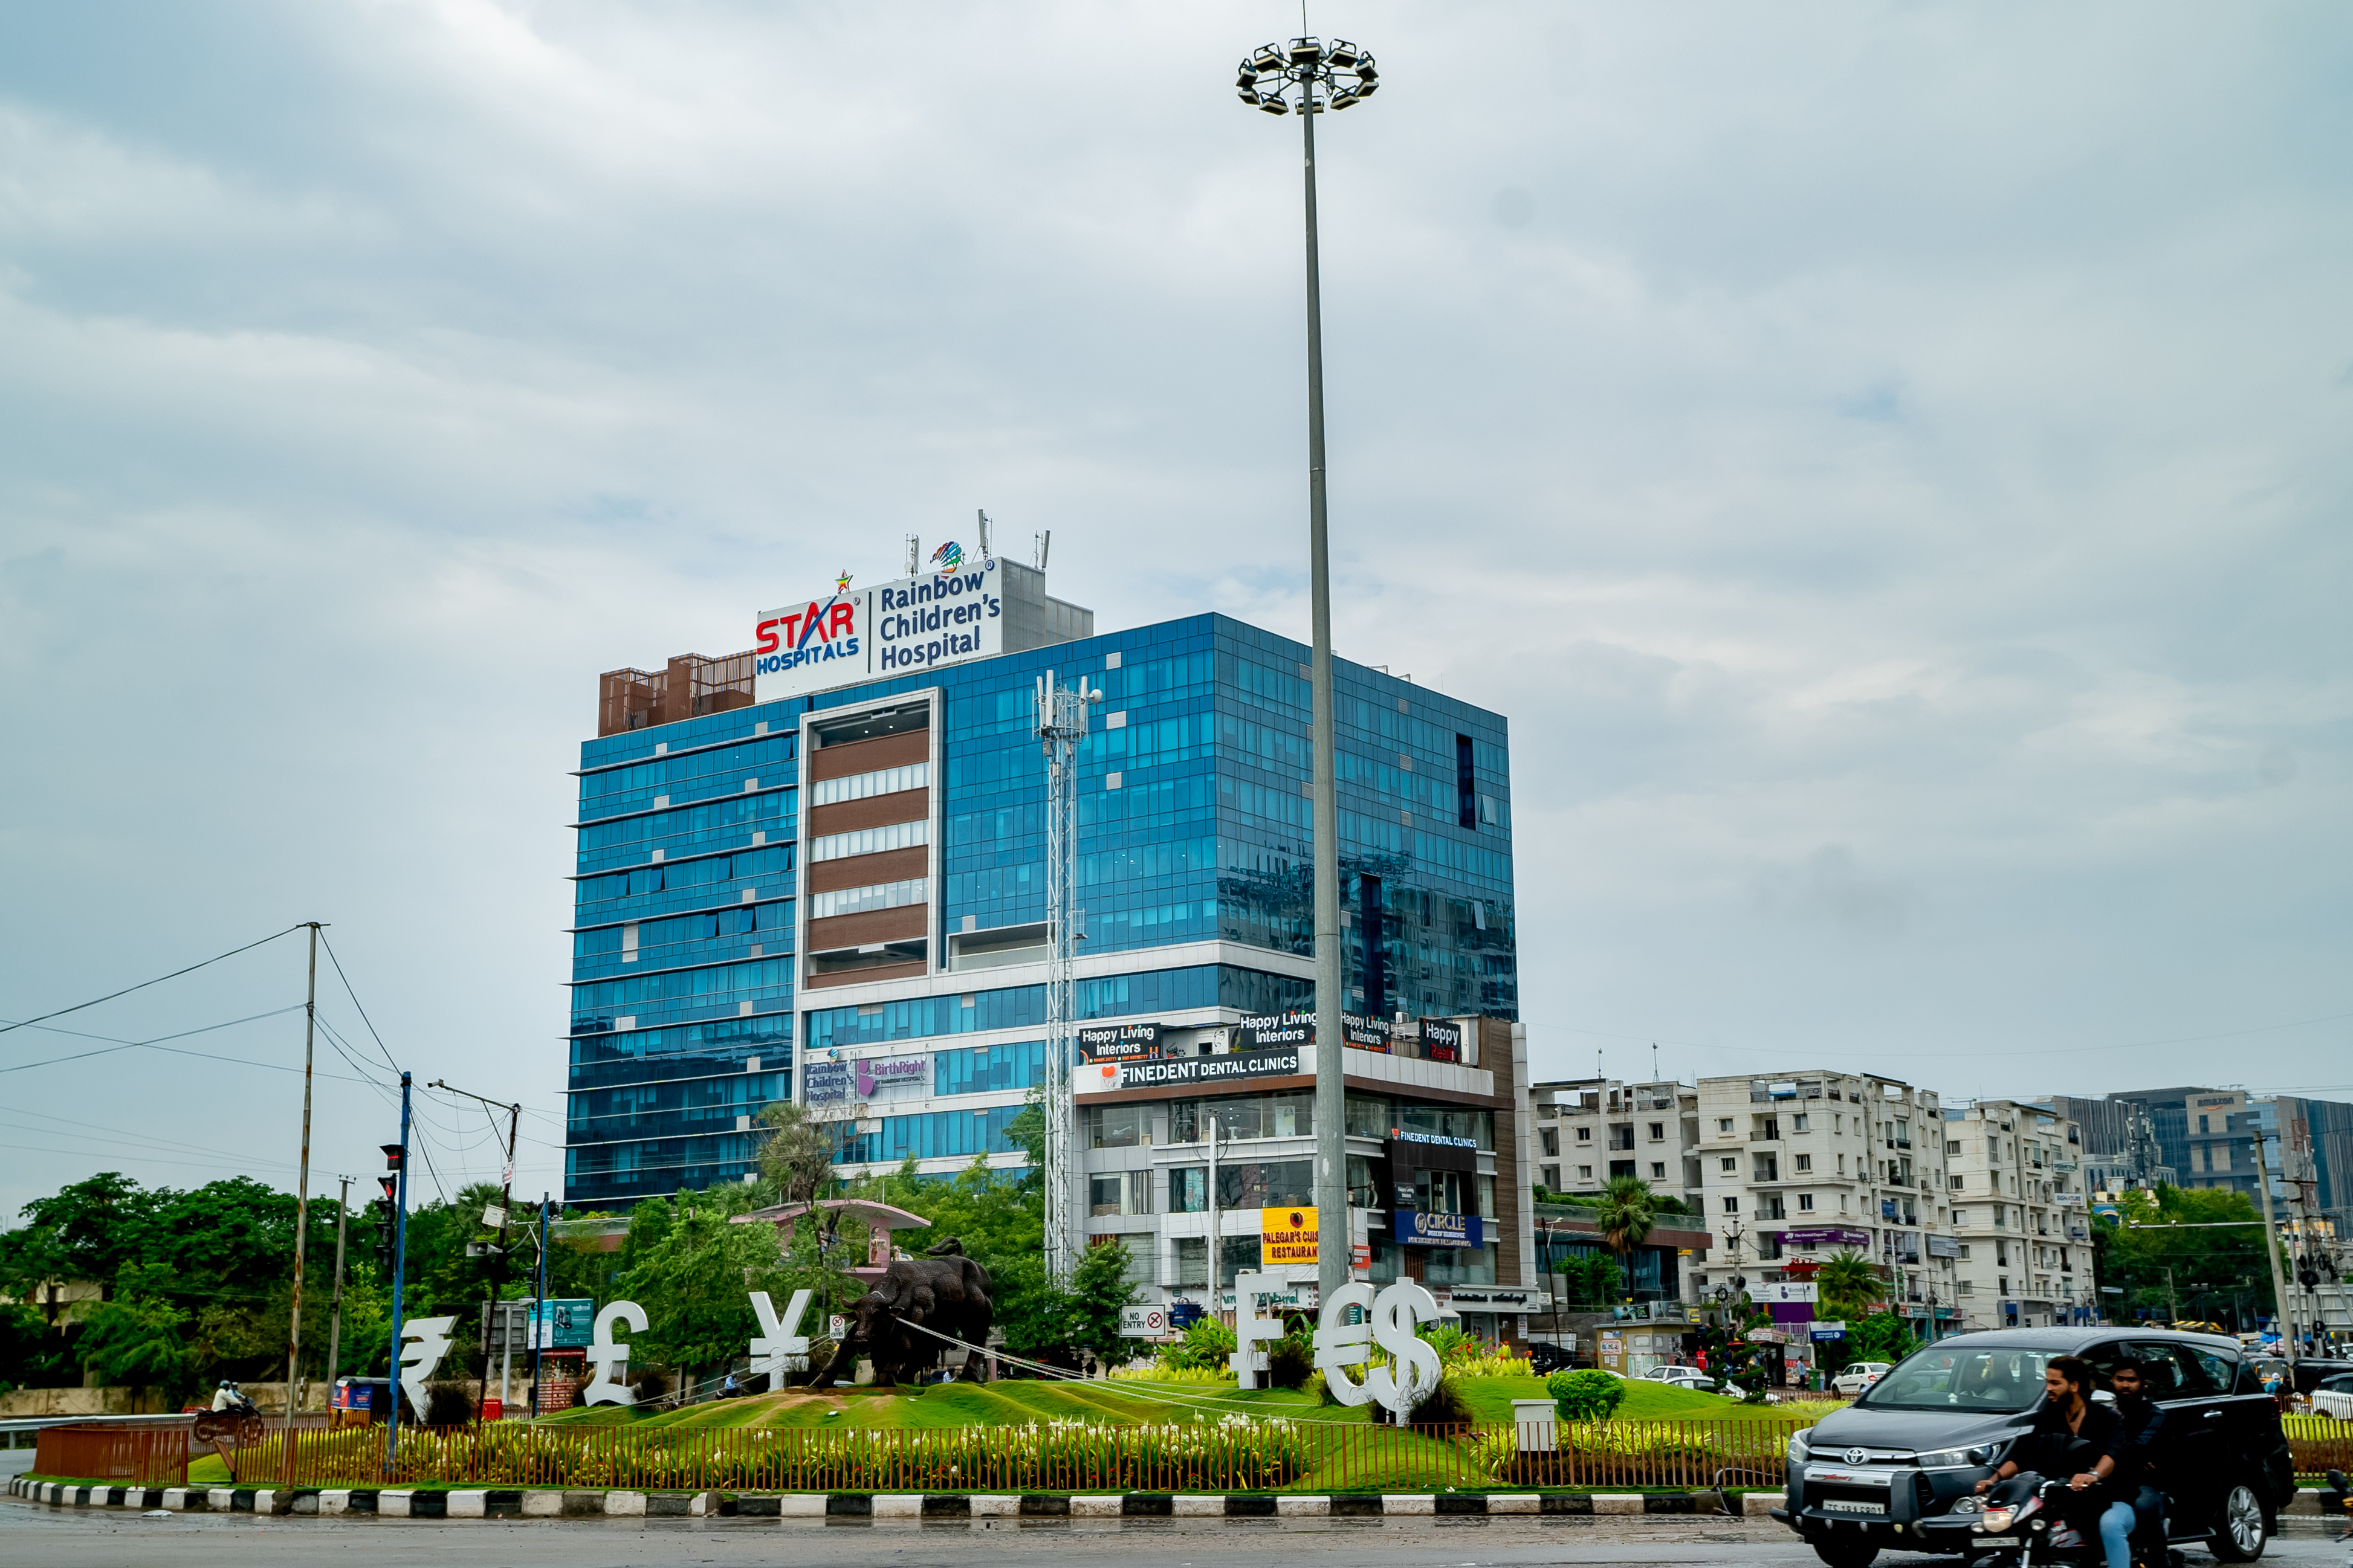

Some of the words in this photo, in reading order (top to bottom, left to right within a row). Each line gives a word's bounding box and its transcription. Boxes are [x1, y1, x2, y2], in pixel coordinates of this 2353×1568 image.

[881, 572, 984, 612] Rainbow
[881, 594, 1000, 640] Children's
[756, 601, 853, 654] STAR
[757, 637, 859, 675] HOSPITALS
[881, 625, 980, 670] Hospital
[1240, 1016, 1280, 1031] Happy
[1283, 1010, 1317, 1027] Living
[1341, 1012, 1364, 1029] Happy
[1366, 1016, 1389, 1034] Living
[1083, 1030, 1118, 1044] Happy
[1121, 1025, 1154, 1040] Living
[1256, 1027, 1305, 1043] Interiors
[1350, 1030, 1381, 1045] Interiors
[1426, 1022, 1459, 1046] Happy
[1096, 1040, 1141, 1056] Interiors
[806, 1063, 847, 1075] Rainbow
[875, 1060, 925, 1076] BirthRight
[1121, 1062, 1199, 1083] FINEDENT
[1200, 1061, 1247, 1076] DENTAL
[1248, 1056, 1297, 1073] CLINICS
[807, 1074, 855, 1088] Children's
[807, 1088, 846, 1102] Hospital
[2198, 1097, 2235, 1107] amazon
[1400, 1131, 1429, 1143] FINEDENT
[1431, 1135, 1453, 1146] DENTAL
[1454, 1137, 1477, 1148] CLINICS
[1427, 1213, 1466, 1231] CIRCLE
[1263, 1230, 1301, 1244] PALEGAR'S
[1272, 1246, 1318, 1259] RESTAURAN
